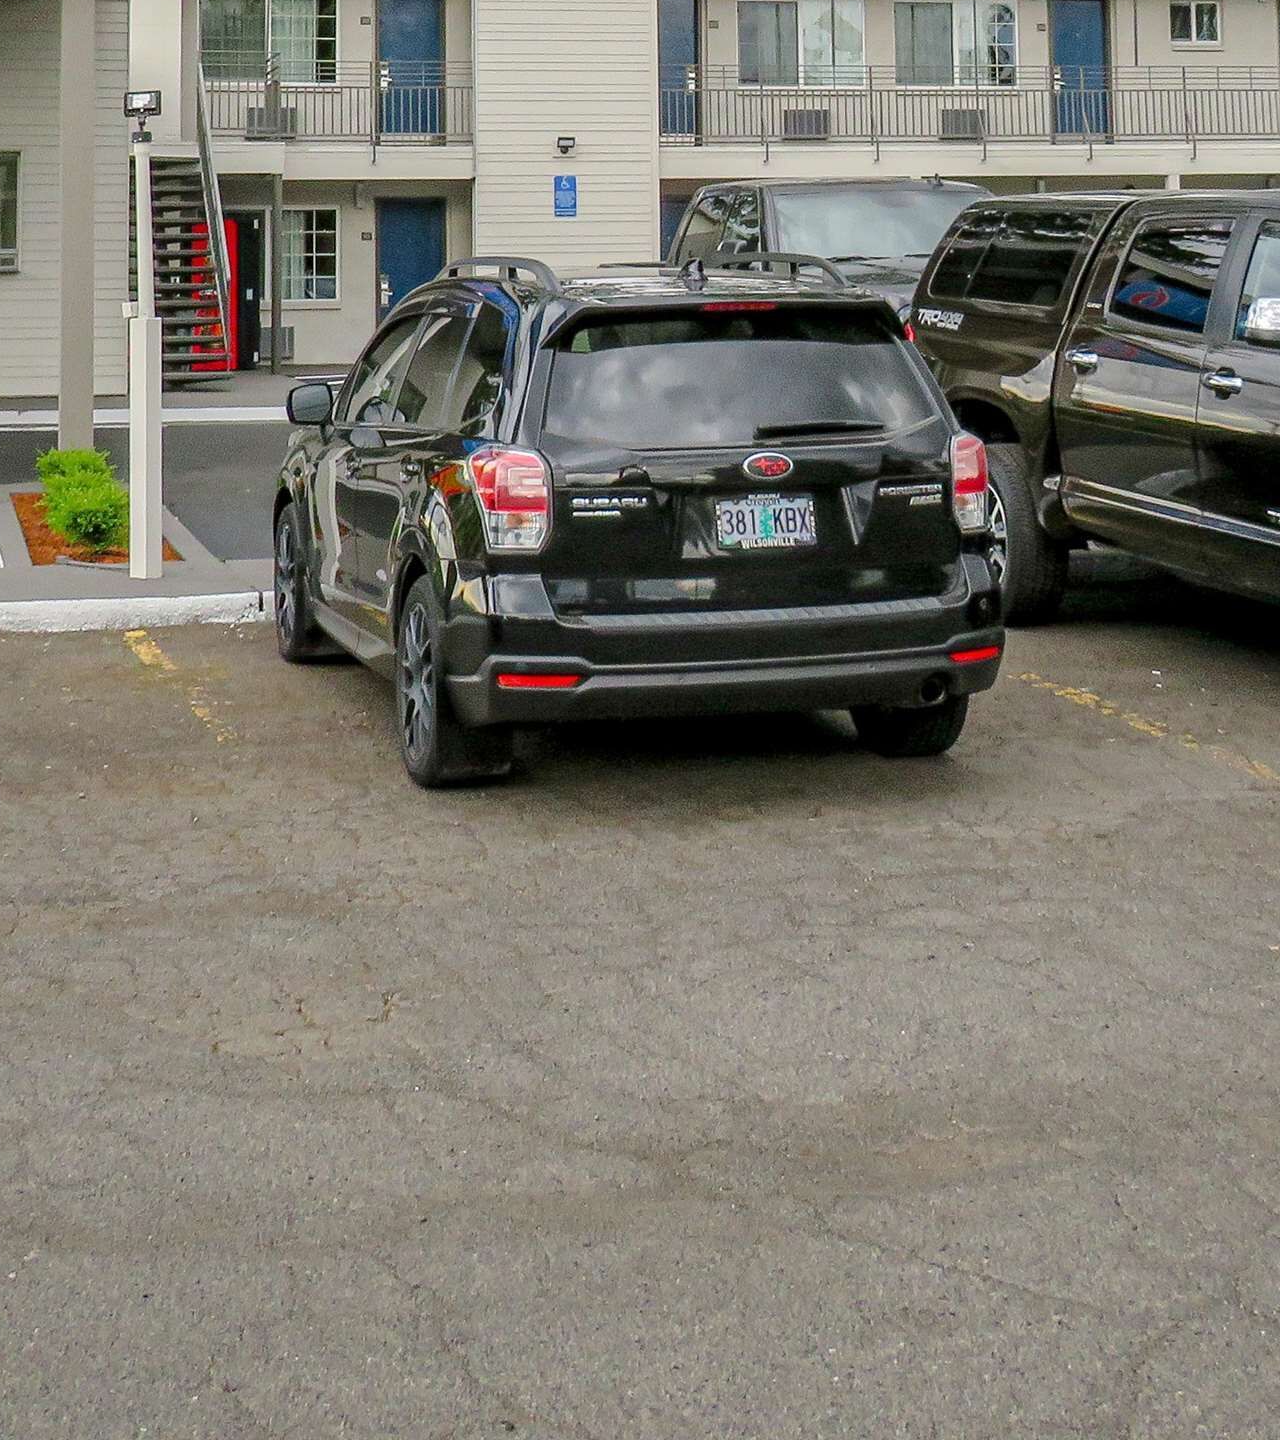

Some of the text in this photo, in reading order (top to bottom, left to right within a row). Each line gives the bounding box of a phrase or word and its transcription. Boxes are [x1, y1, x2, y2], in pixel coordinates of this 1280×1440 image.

[571, 497, 648, 509] SUBARU
[722, 507, 810, 536] 381 KBX
[739, 536, 797, 550] WILSONVILLE
